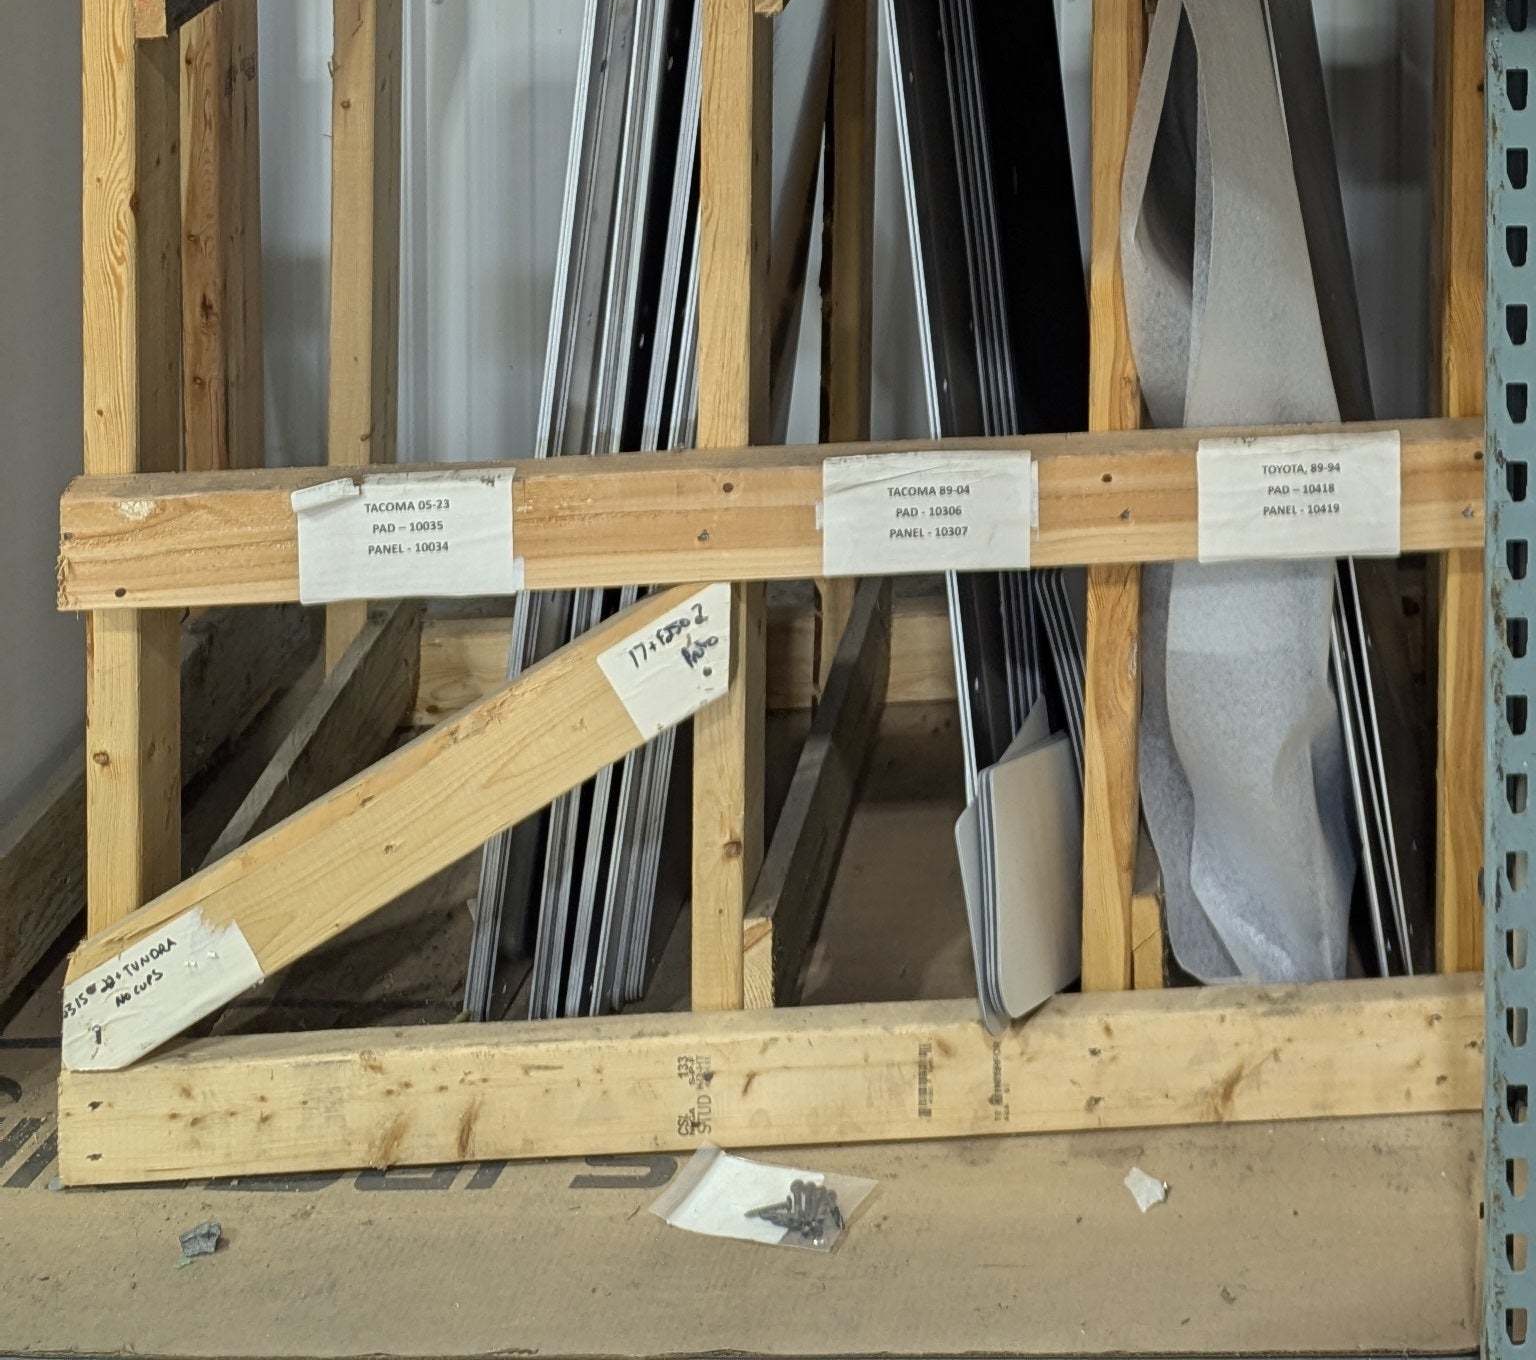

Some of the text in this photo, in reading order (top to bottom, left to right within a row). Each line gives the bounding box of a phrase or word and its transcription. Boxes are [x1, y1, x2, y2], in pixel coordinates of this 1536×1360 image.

[1261, 462, 1341, 476] TOYOTA, 89-94
[887, 484, 971, 497] TACOMA 89-04
[1267, 485, 1291, 497] PAD
[1302, 482, 1335, 496] 10418
[363, 498, 450, 514] TACOMA 05-23
[895, 507, 919, 518] PAD
[929, 505, 963, 517] 10306
[1262, 504, 1298, 517] PANEL
[1307, 503, 1340, 516] 10419
[372, 522, 396, 535] PAD
[409, 520, 444, 533] 10035
[889, 527, 925, 539] PANEL
[935, 525, 969, 538] 10307
[368, 543, 405, 556] PANEL
[415, 541, 449, 553] 10034
[123, 937, 177, 977] TUNDRA
[134, 969, 164, 995] CUPS
[677, 1056, 690, 1080] 133
